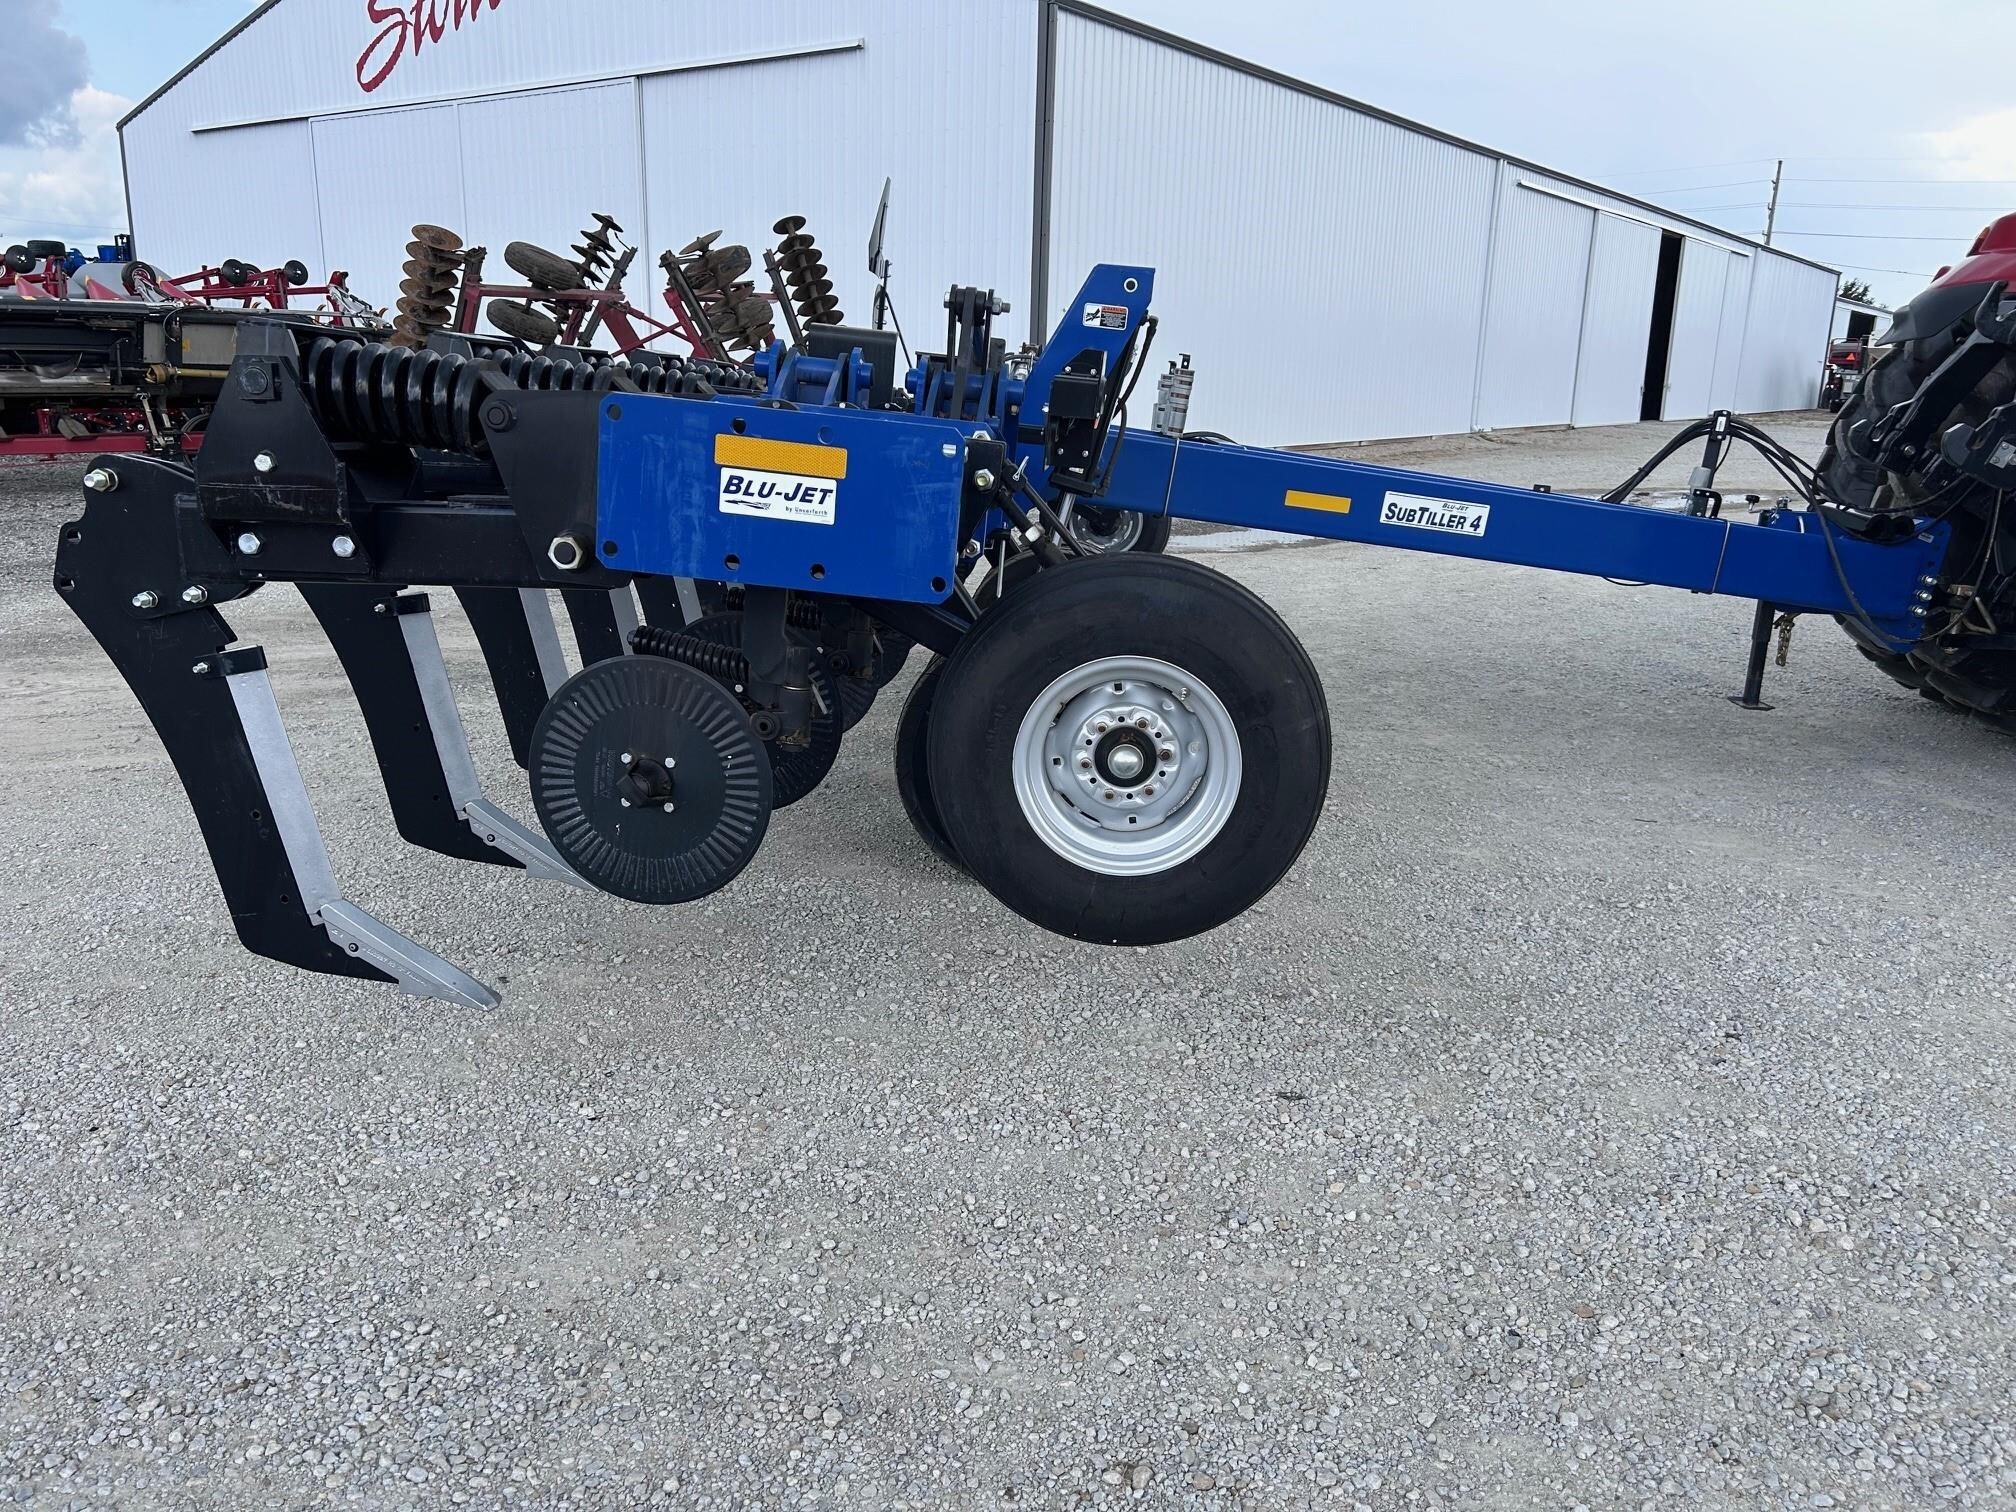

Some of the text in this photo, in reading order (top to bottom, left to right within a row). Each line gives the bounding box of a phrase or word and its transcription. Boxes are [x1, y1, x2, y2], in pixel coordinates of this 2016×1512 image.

[722, 474, 833, 505] BLU-JET
[785, 505, 793, 513] by
[1442, 503, 1469, 512] BLU-JET
[1469, 515, 1483, 532] 4
